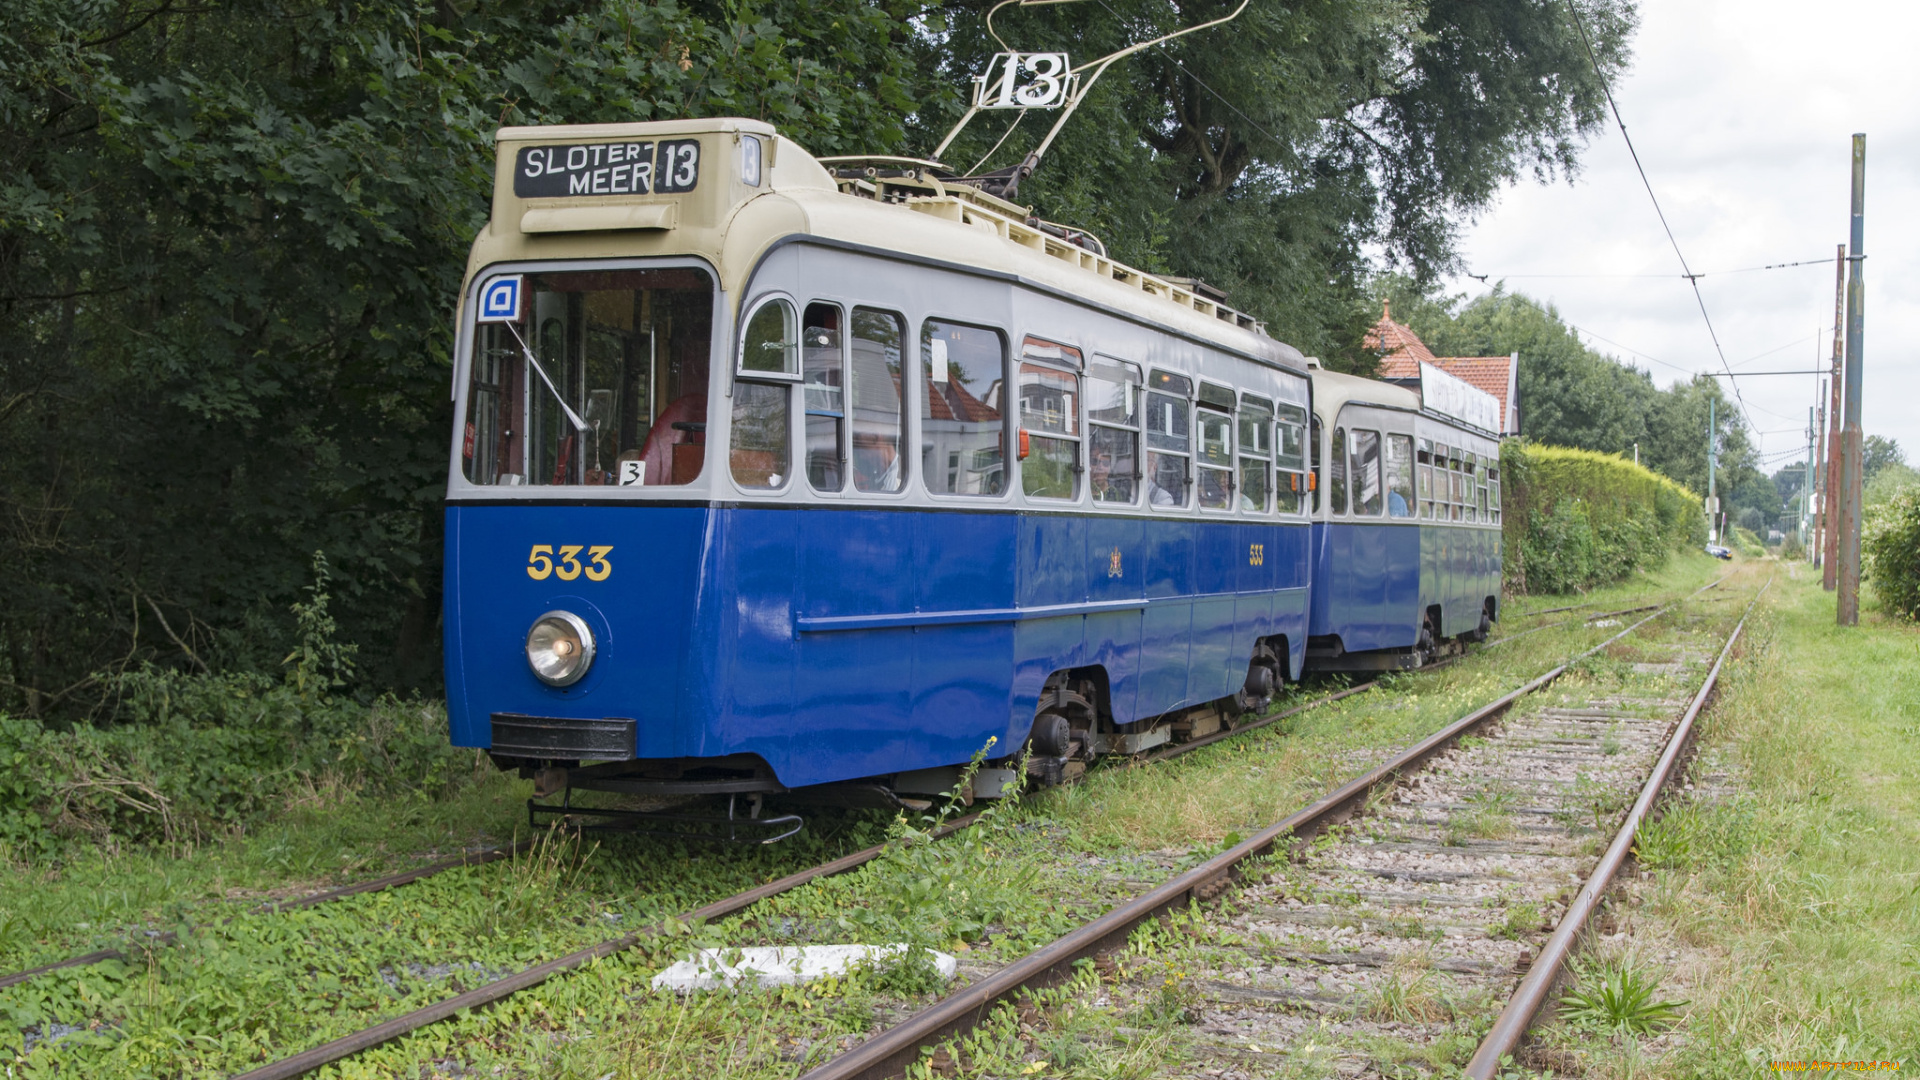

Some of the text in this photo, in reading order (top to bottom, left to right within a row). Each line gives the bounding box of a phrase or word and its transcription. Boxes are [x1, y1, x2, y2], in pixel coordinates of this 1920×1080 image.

[994, 53, 1062, 105] 13
[569, 162, 652, 195] MEER
[665, 144, 698, 187] 13
[622, 462, 640, 486] 3
[526, 544, 614, 581] 533
[1249, 544, 1264, 566] 533
